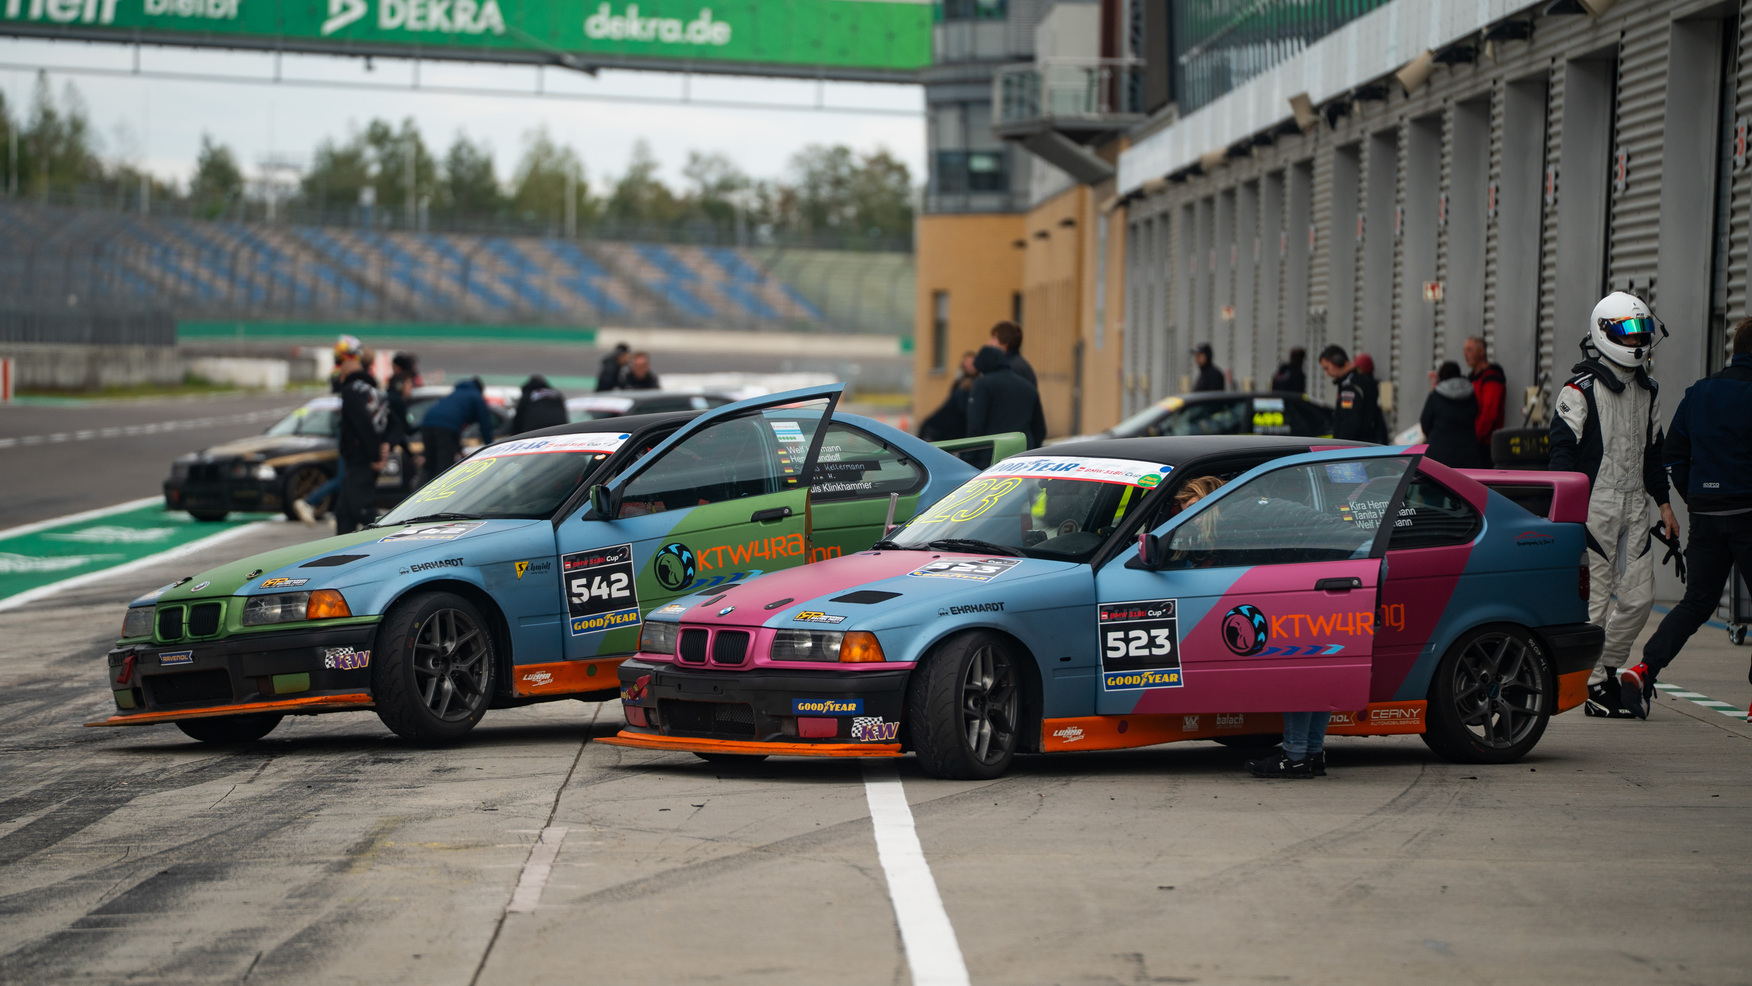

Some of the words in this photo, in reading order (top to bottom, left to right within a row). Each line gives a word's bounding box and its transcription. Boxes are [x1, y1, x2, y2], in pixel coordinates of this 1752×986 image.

[377, 0, 507, 34] DEKRA
[584, 6, 731, 45] dekra.de
[787, 446, 805, 455] Welf
[822, 481, 873, 493] Klinkhammer
[1348, 501, 1367, 511] Kira
[1353, 510, 1378, 520] Tanita
[1355, 519, 1375, 529] Welf
[409, 557, 465, 574] EHRHARDT
[518, 561, 551, 572] Schmidt
[572, 560, 589, 568] BMW
[926, 562, 1002, 574] 523
[571, 572, 631, 604] 542
[949, 601, 1005, 616] EHRHARDT
[1110, 611, 1128, 619] BMW
[1128, 609, 1147, 618] 318ti
[1147, 609, 1163, 617] Cup
[573, 612, 638, 631] GOODYEAR
[1106, 628, 1172, 658] 523
[162, 654, 189, 663] RAVENOL
[334, 650, 371, 671] KW
[1107, 671, 1179, 687] GOODYEAR
[797, 700, 857, 714] GOODYEAR
[1370, 708, 1421, 719] CERNY
[860, 721, 900, 742] KW
